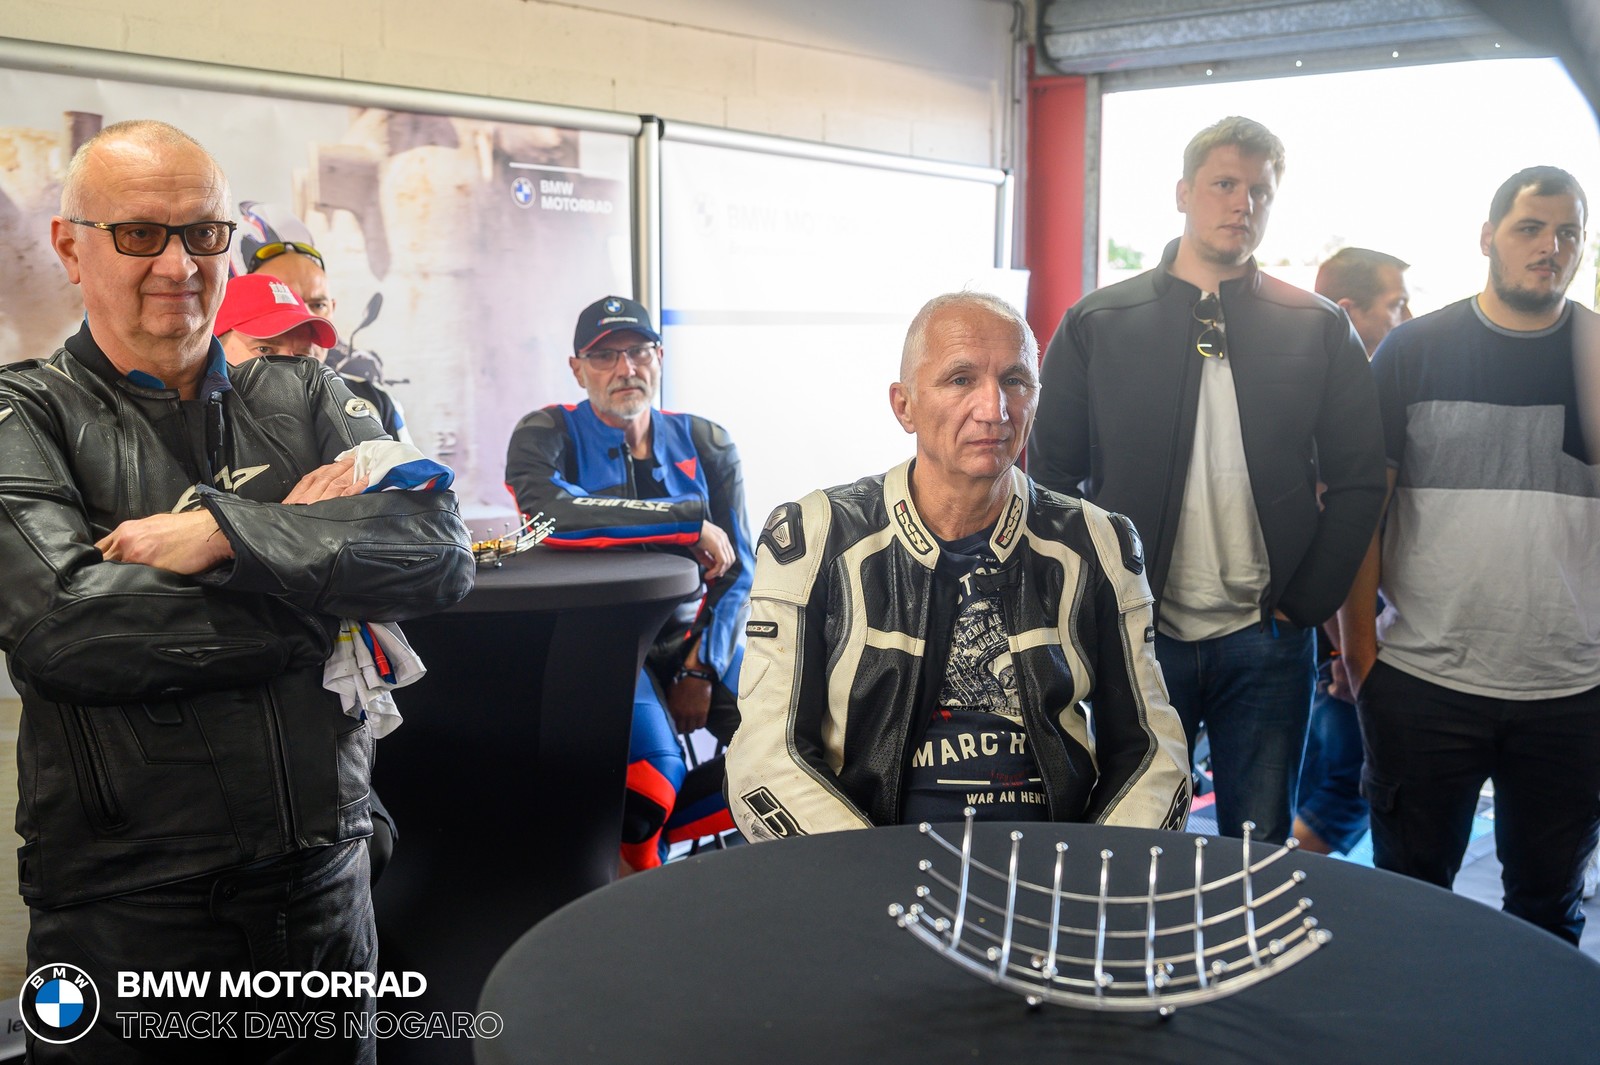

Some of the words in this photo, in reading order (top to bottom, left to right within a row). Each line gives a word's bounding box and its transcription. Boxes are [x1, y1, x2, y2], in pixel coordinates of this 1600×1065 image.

[540, 180, 574, 195] BMW
[540, 196, 613, 214] MOTORRAD
[966, 792, 994, 805] WAR
[999, 791, 1016, 803] AN
